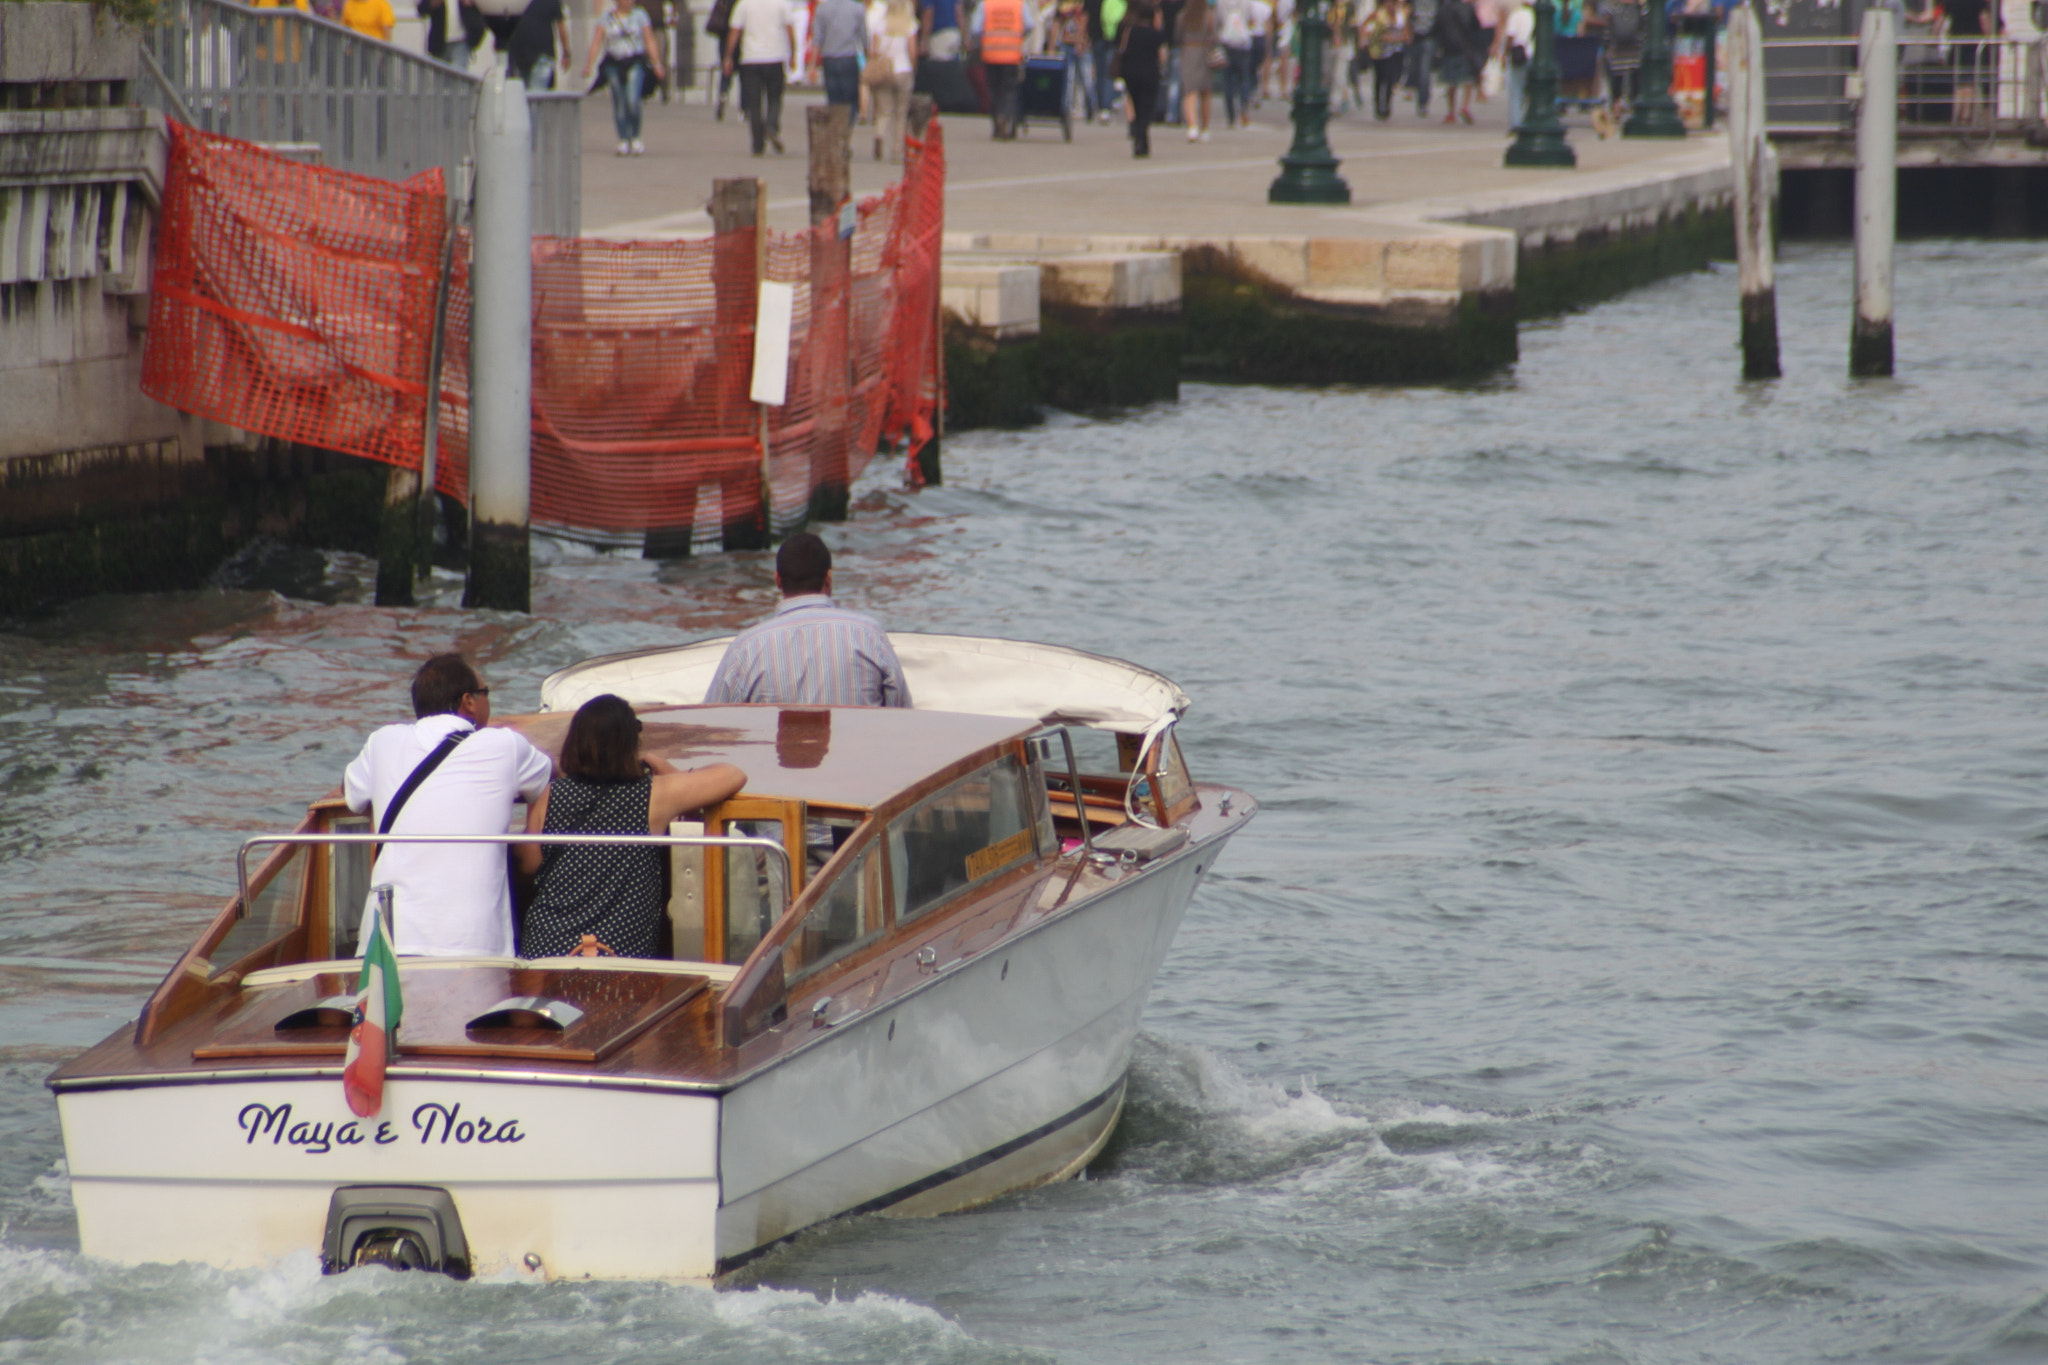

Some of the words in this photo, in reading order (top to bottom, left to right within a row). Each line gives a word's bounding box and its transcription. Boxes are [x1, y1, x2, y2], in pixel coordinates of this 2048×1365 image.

[238, 1103, 365, 1154] Maya
[374, 1121, 399, 1145] e
[412, 1102, 526, 1145] Nora
